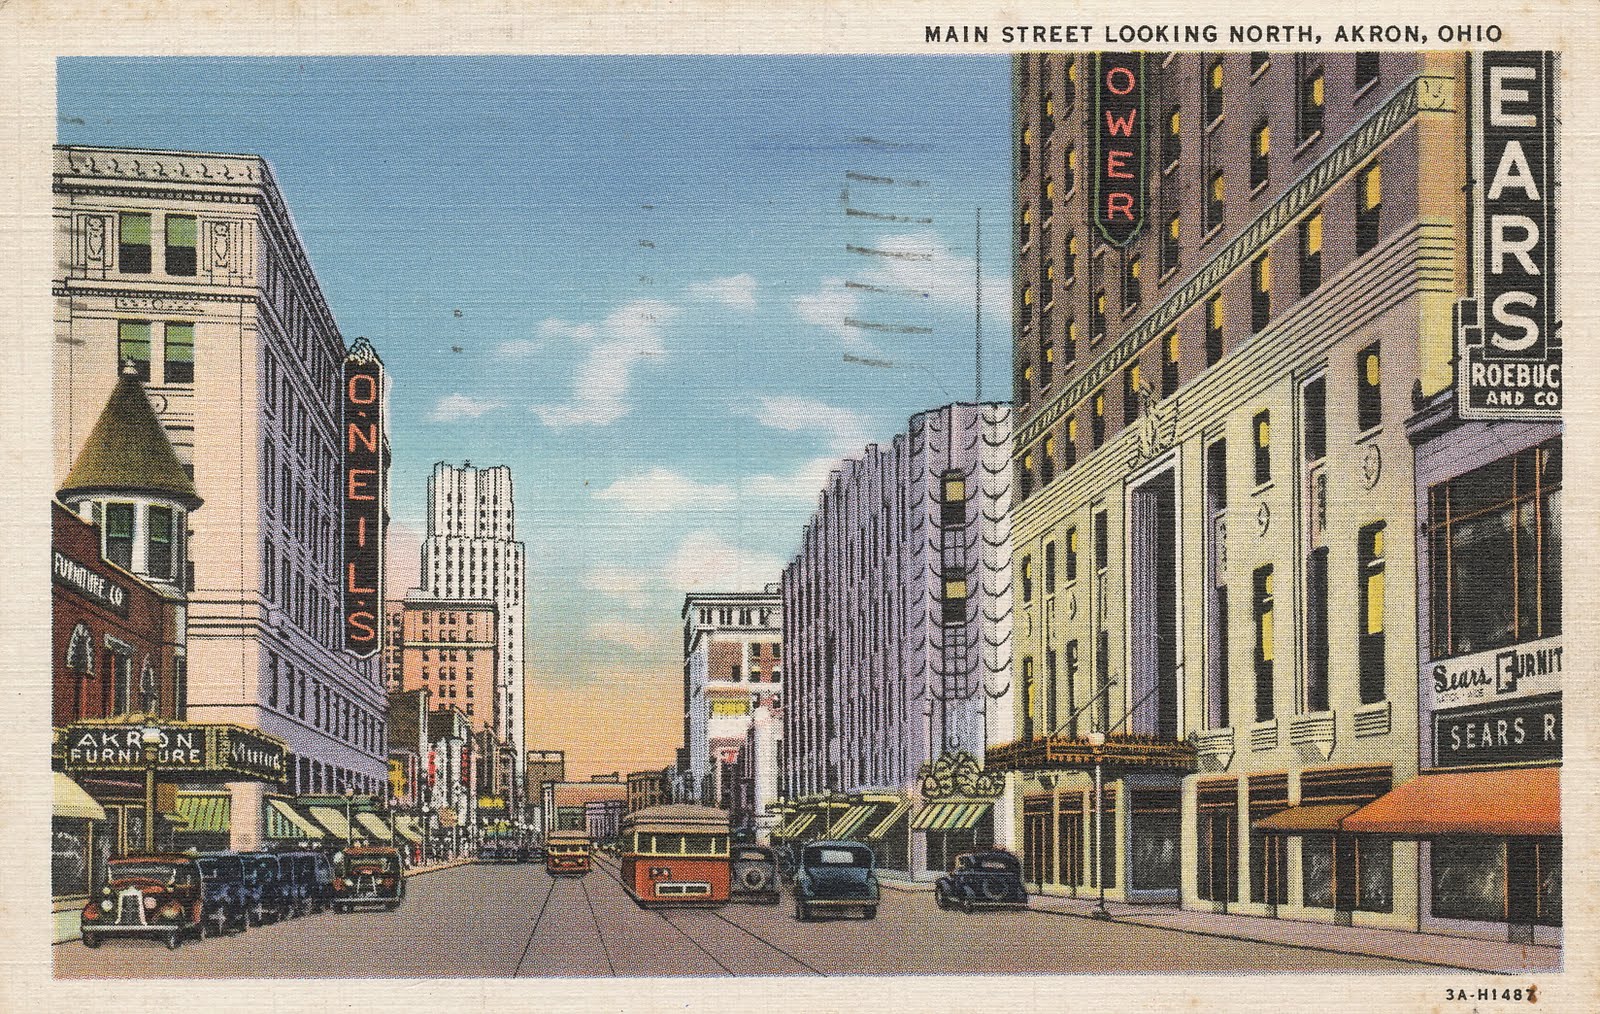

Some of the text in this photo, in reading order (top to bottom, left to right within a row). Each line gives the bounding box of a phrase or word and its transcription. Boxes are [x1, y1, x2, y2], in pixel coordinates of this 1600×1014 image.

[1105, 66, 1137, 222] OWER
[1487, 66, 1541, 352] EARS
[1471, 362, 1560, 389] ROEBUC
[1485, 390, 1559, 406] AND CO
[1432, 664, 1493, 694] Sears
[1450, 712, 1556, 750] SEARS R
[70, 748, 200, 764] FURNIURE
